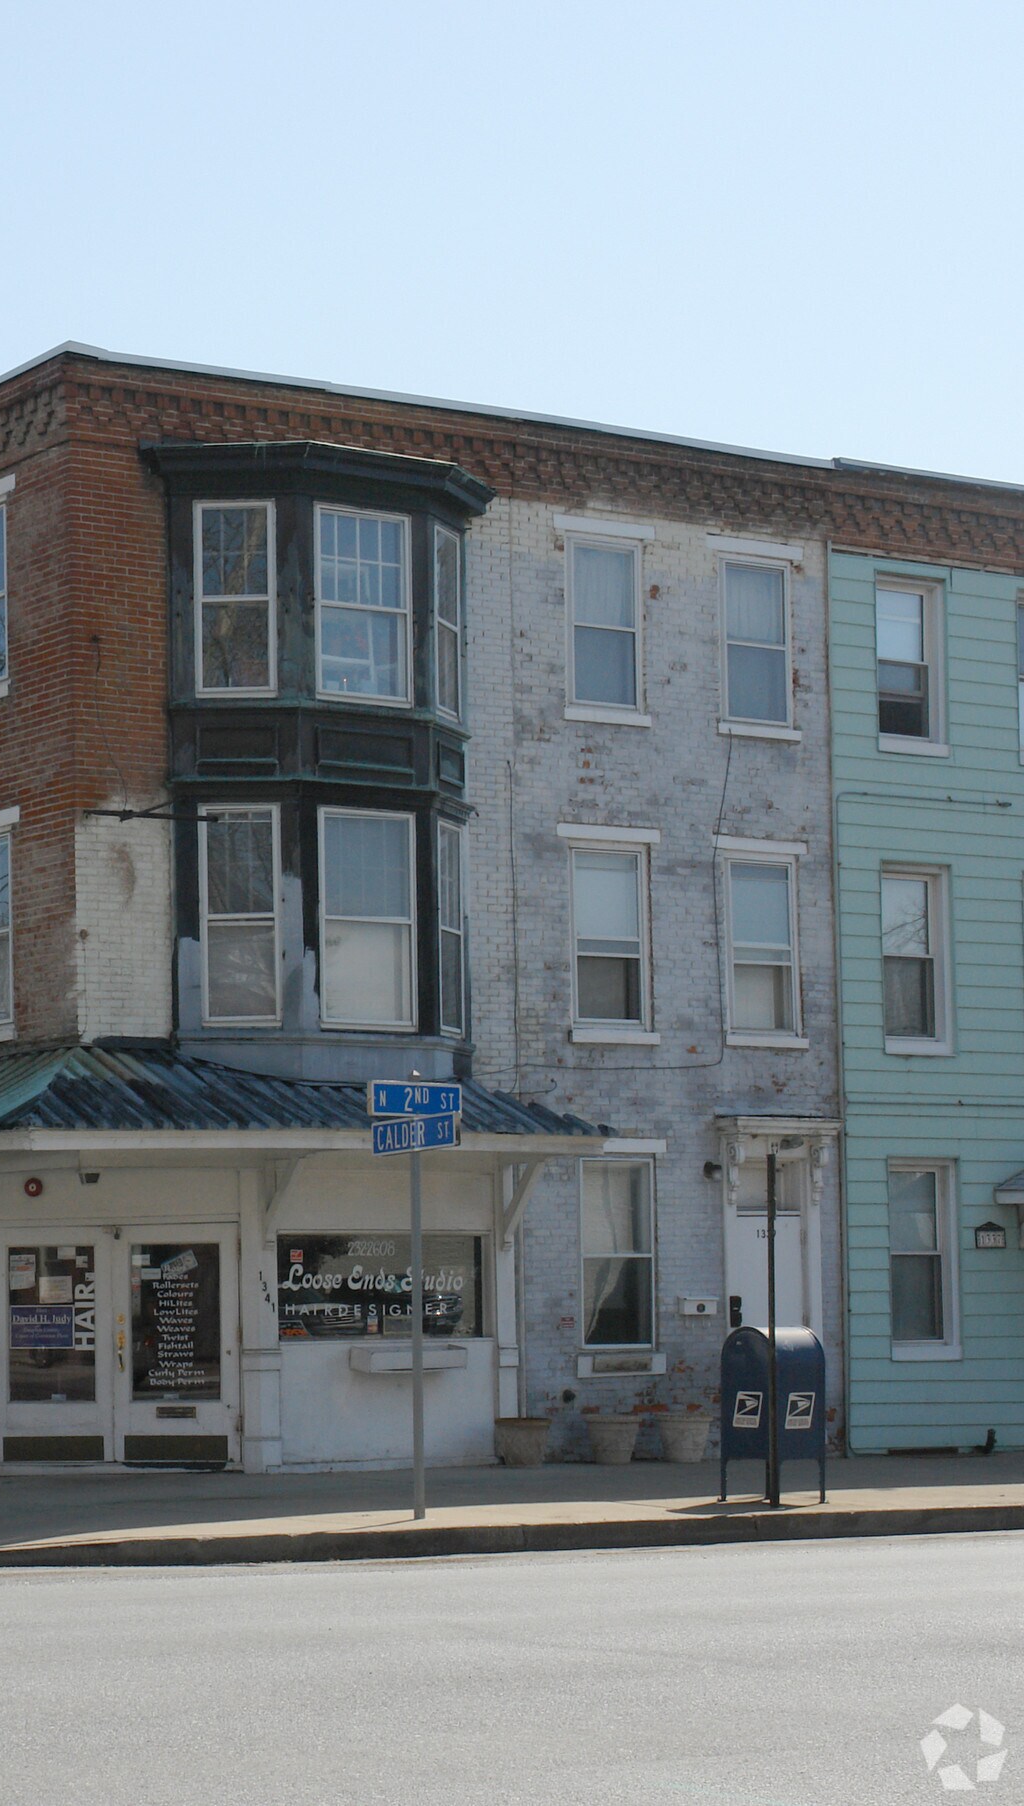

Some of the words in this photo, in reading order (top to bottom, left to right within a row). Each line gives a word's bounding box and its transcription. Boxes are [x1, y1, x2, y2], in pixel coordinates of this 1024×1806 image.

[379, 1090, 387, 1107] N
[404, 1087, 430, 1112] 2ND
[440, 1093, 454, 1109] ST
[377, 1121, 425, 1151] CALDER
[437, 1121, 449, 1139] ST
[280, 1263, 343, 1291] Loose
[347, 1265, 396, 1290] Ends
[400, 1266, 463, 1291] Sudio
[157, 1290, 194, 1298] Colours
[12, 1314, 38, 1323] David
[52, 1314, 71, 1324] Judy
[74, 1281, 95, 1350] HAIR
[159, 1360, 193, 1369] Wraps
[148, 1369, 175, 1378] Curly
